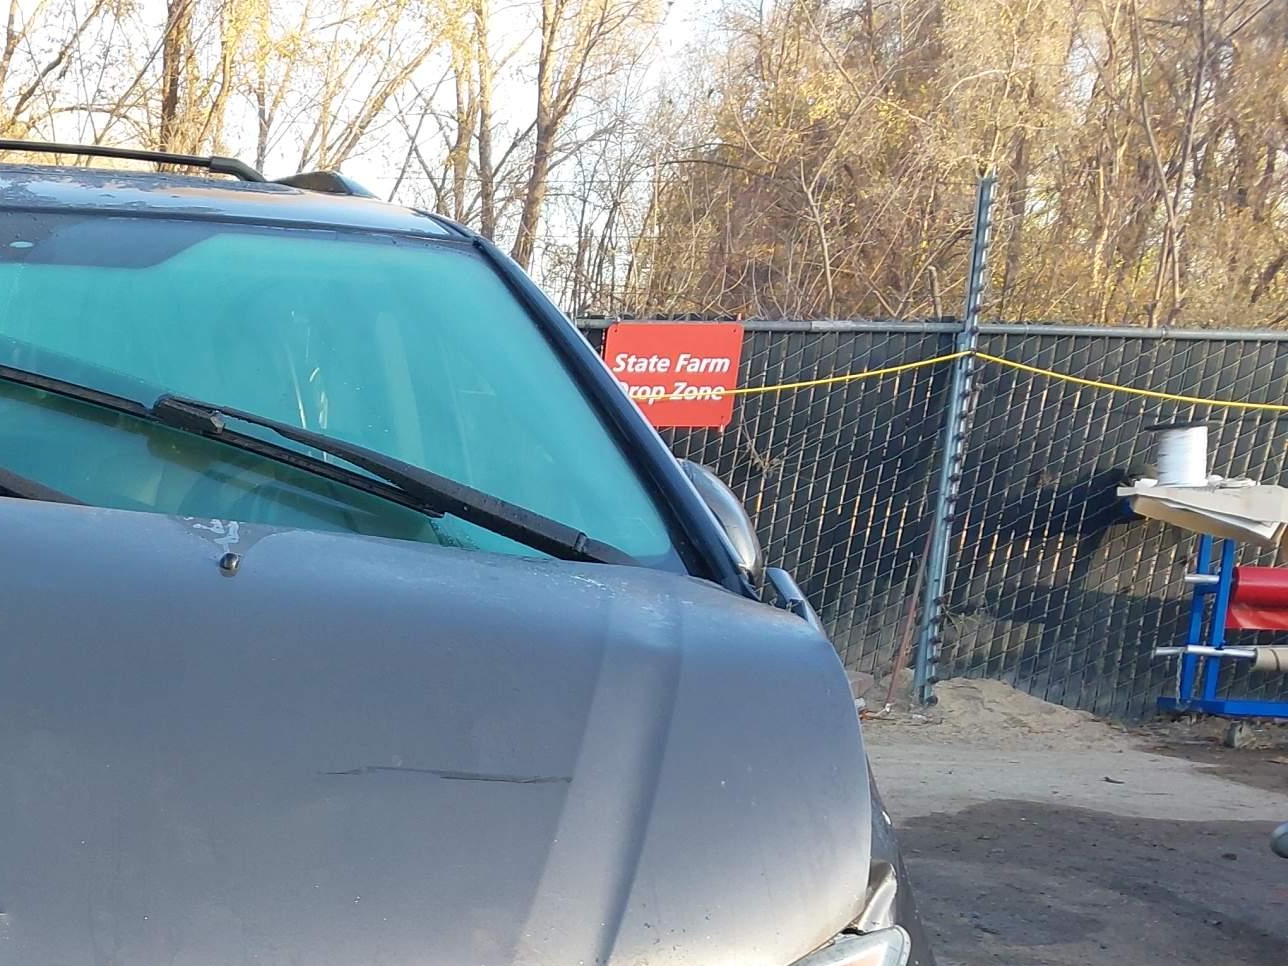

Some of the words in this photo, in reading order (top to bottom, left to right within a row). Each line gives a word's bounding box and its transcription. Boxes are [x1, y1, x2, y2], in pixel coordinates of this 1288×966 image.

[612, 353, 670, 373] State
[675, 353, 731, 373] Farm
[669, 382, 725, 400] Zone
